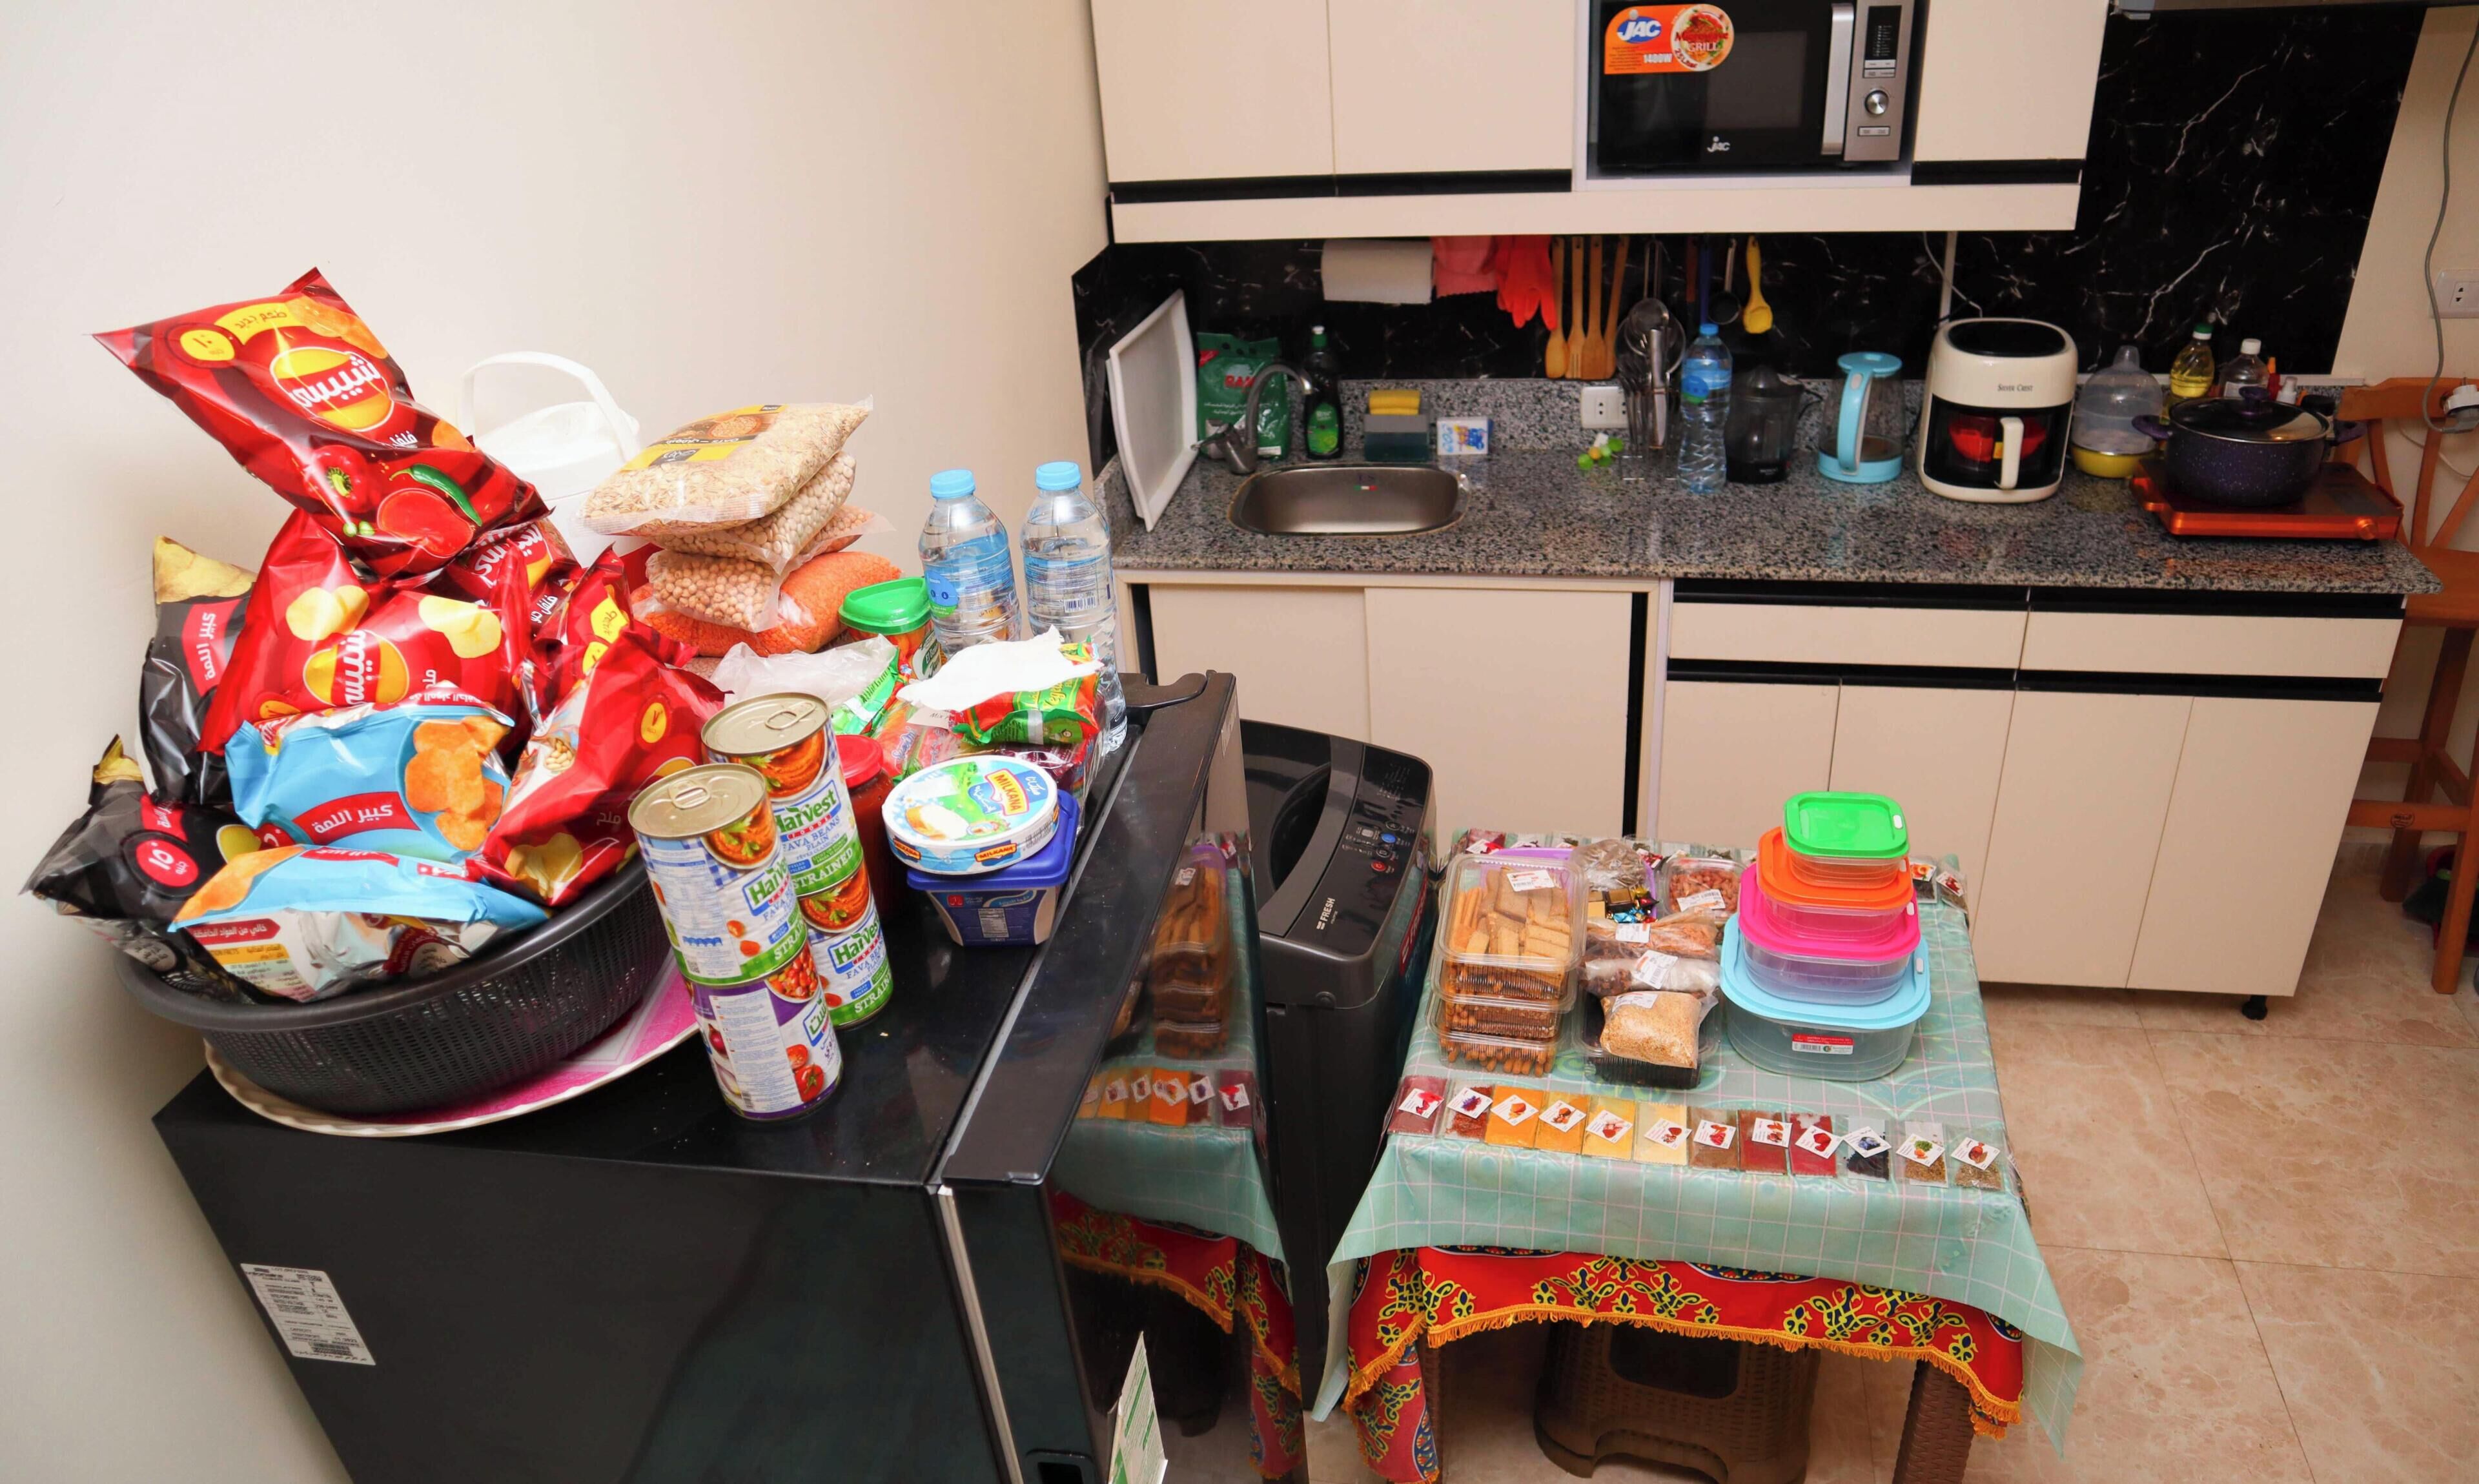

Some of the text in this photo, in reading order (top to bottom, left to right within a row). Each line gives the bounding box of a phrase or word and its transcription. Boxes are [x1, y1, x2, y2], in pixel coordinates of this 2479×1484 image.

[1617, 9, 1662, 41] JAC
[1688, 41, 1717, 52] GRILL
[536, 595, 558, 615] فلفل
[196, 612, 217, 681] كبير اللمة
[994, 773, 1023, 812] MILKANA
[311, 804, 393, 834] كبير اللمة
[596, 811, 622, 826] ملح
[810, 815, 841, 841] BEANS
[806, 834, 830, 851] PLAIN
[979, 845, 1014, 859] MILKANA
[793, 848, 853, 889] STRAINED
[1319, 897, 1336, 922] FRESH
[846, 960, 869, 979] FAVA
